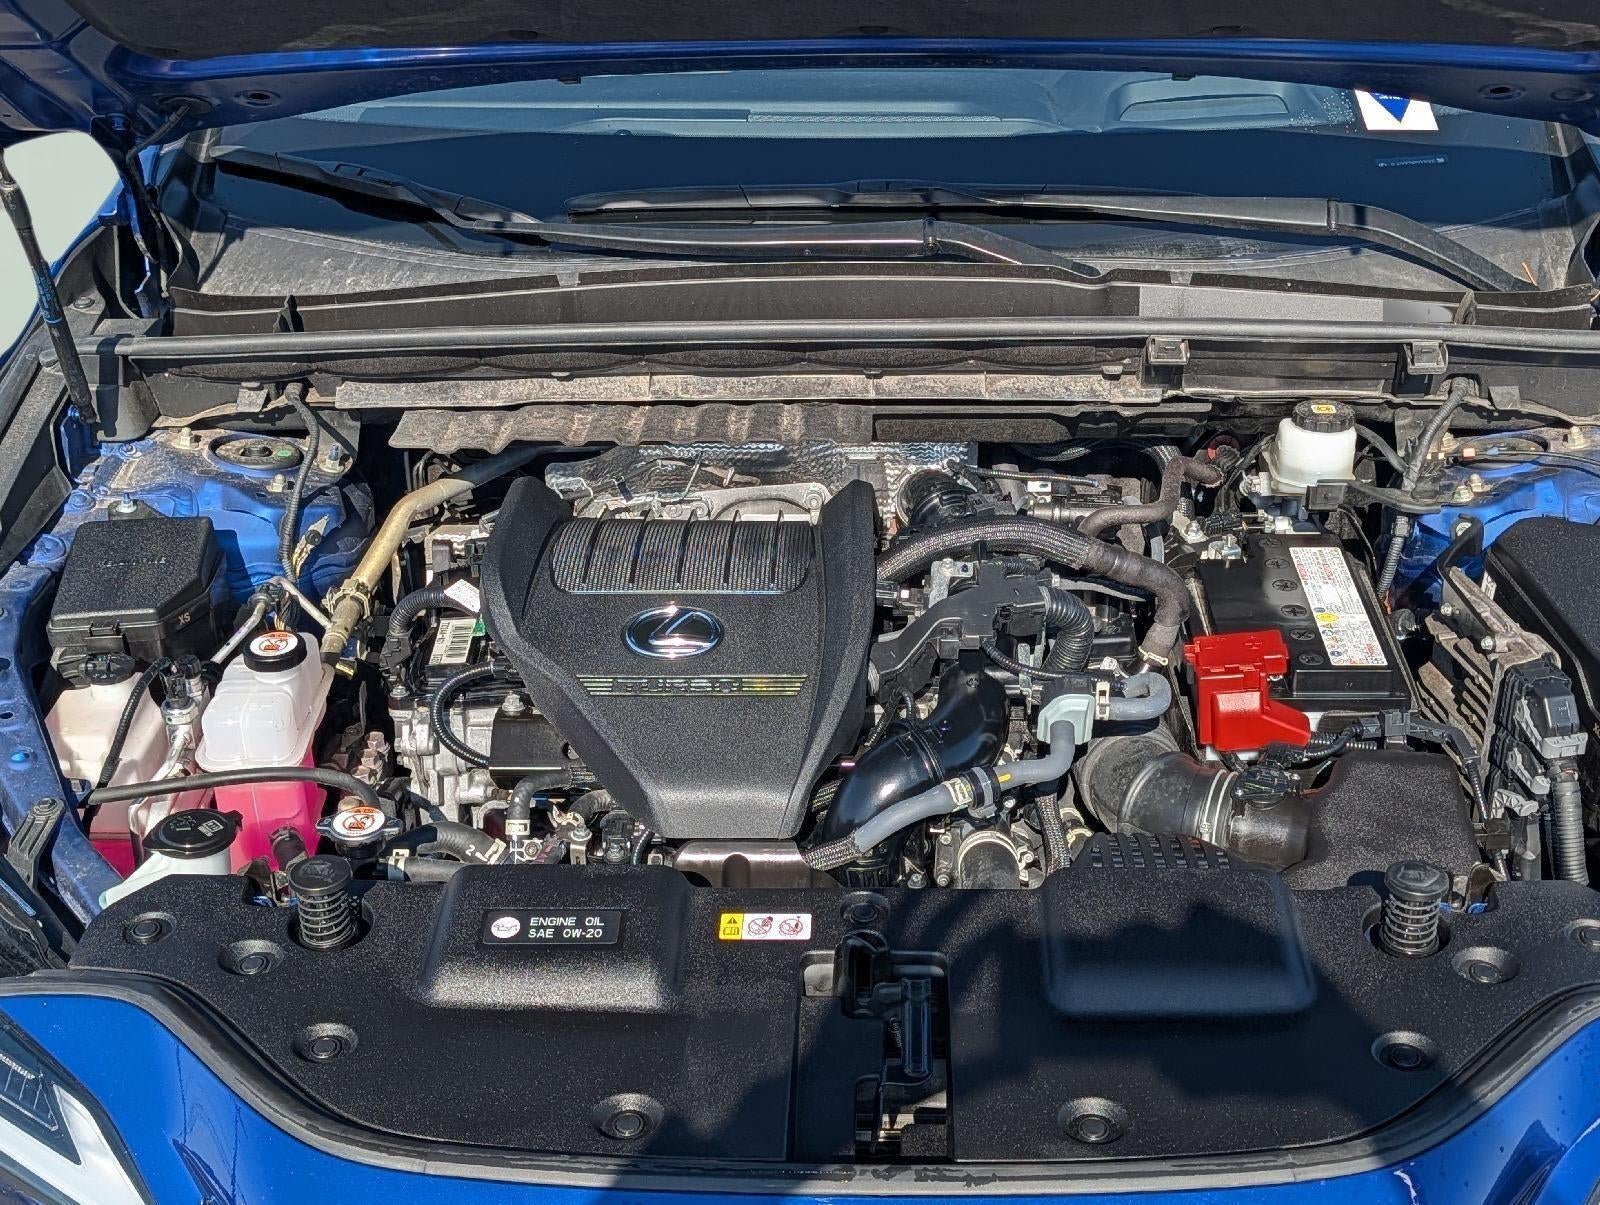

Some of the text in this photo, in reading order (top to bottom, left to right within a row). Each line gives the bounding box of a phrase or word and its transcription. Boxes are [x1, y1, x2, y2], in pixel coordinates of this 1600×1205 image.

[617, 678, 740, 693] TURBO
[529, 916, 605, 926] ENGINE OIL
[528, 928, 603, 938] SAE 0W-20
